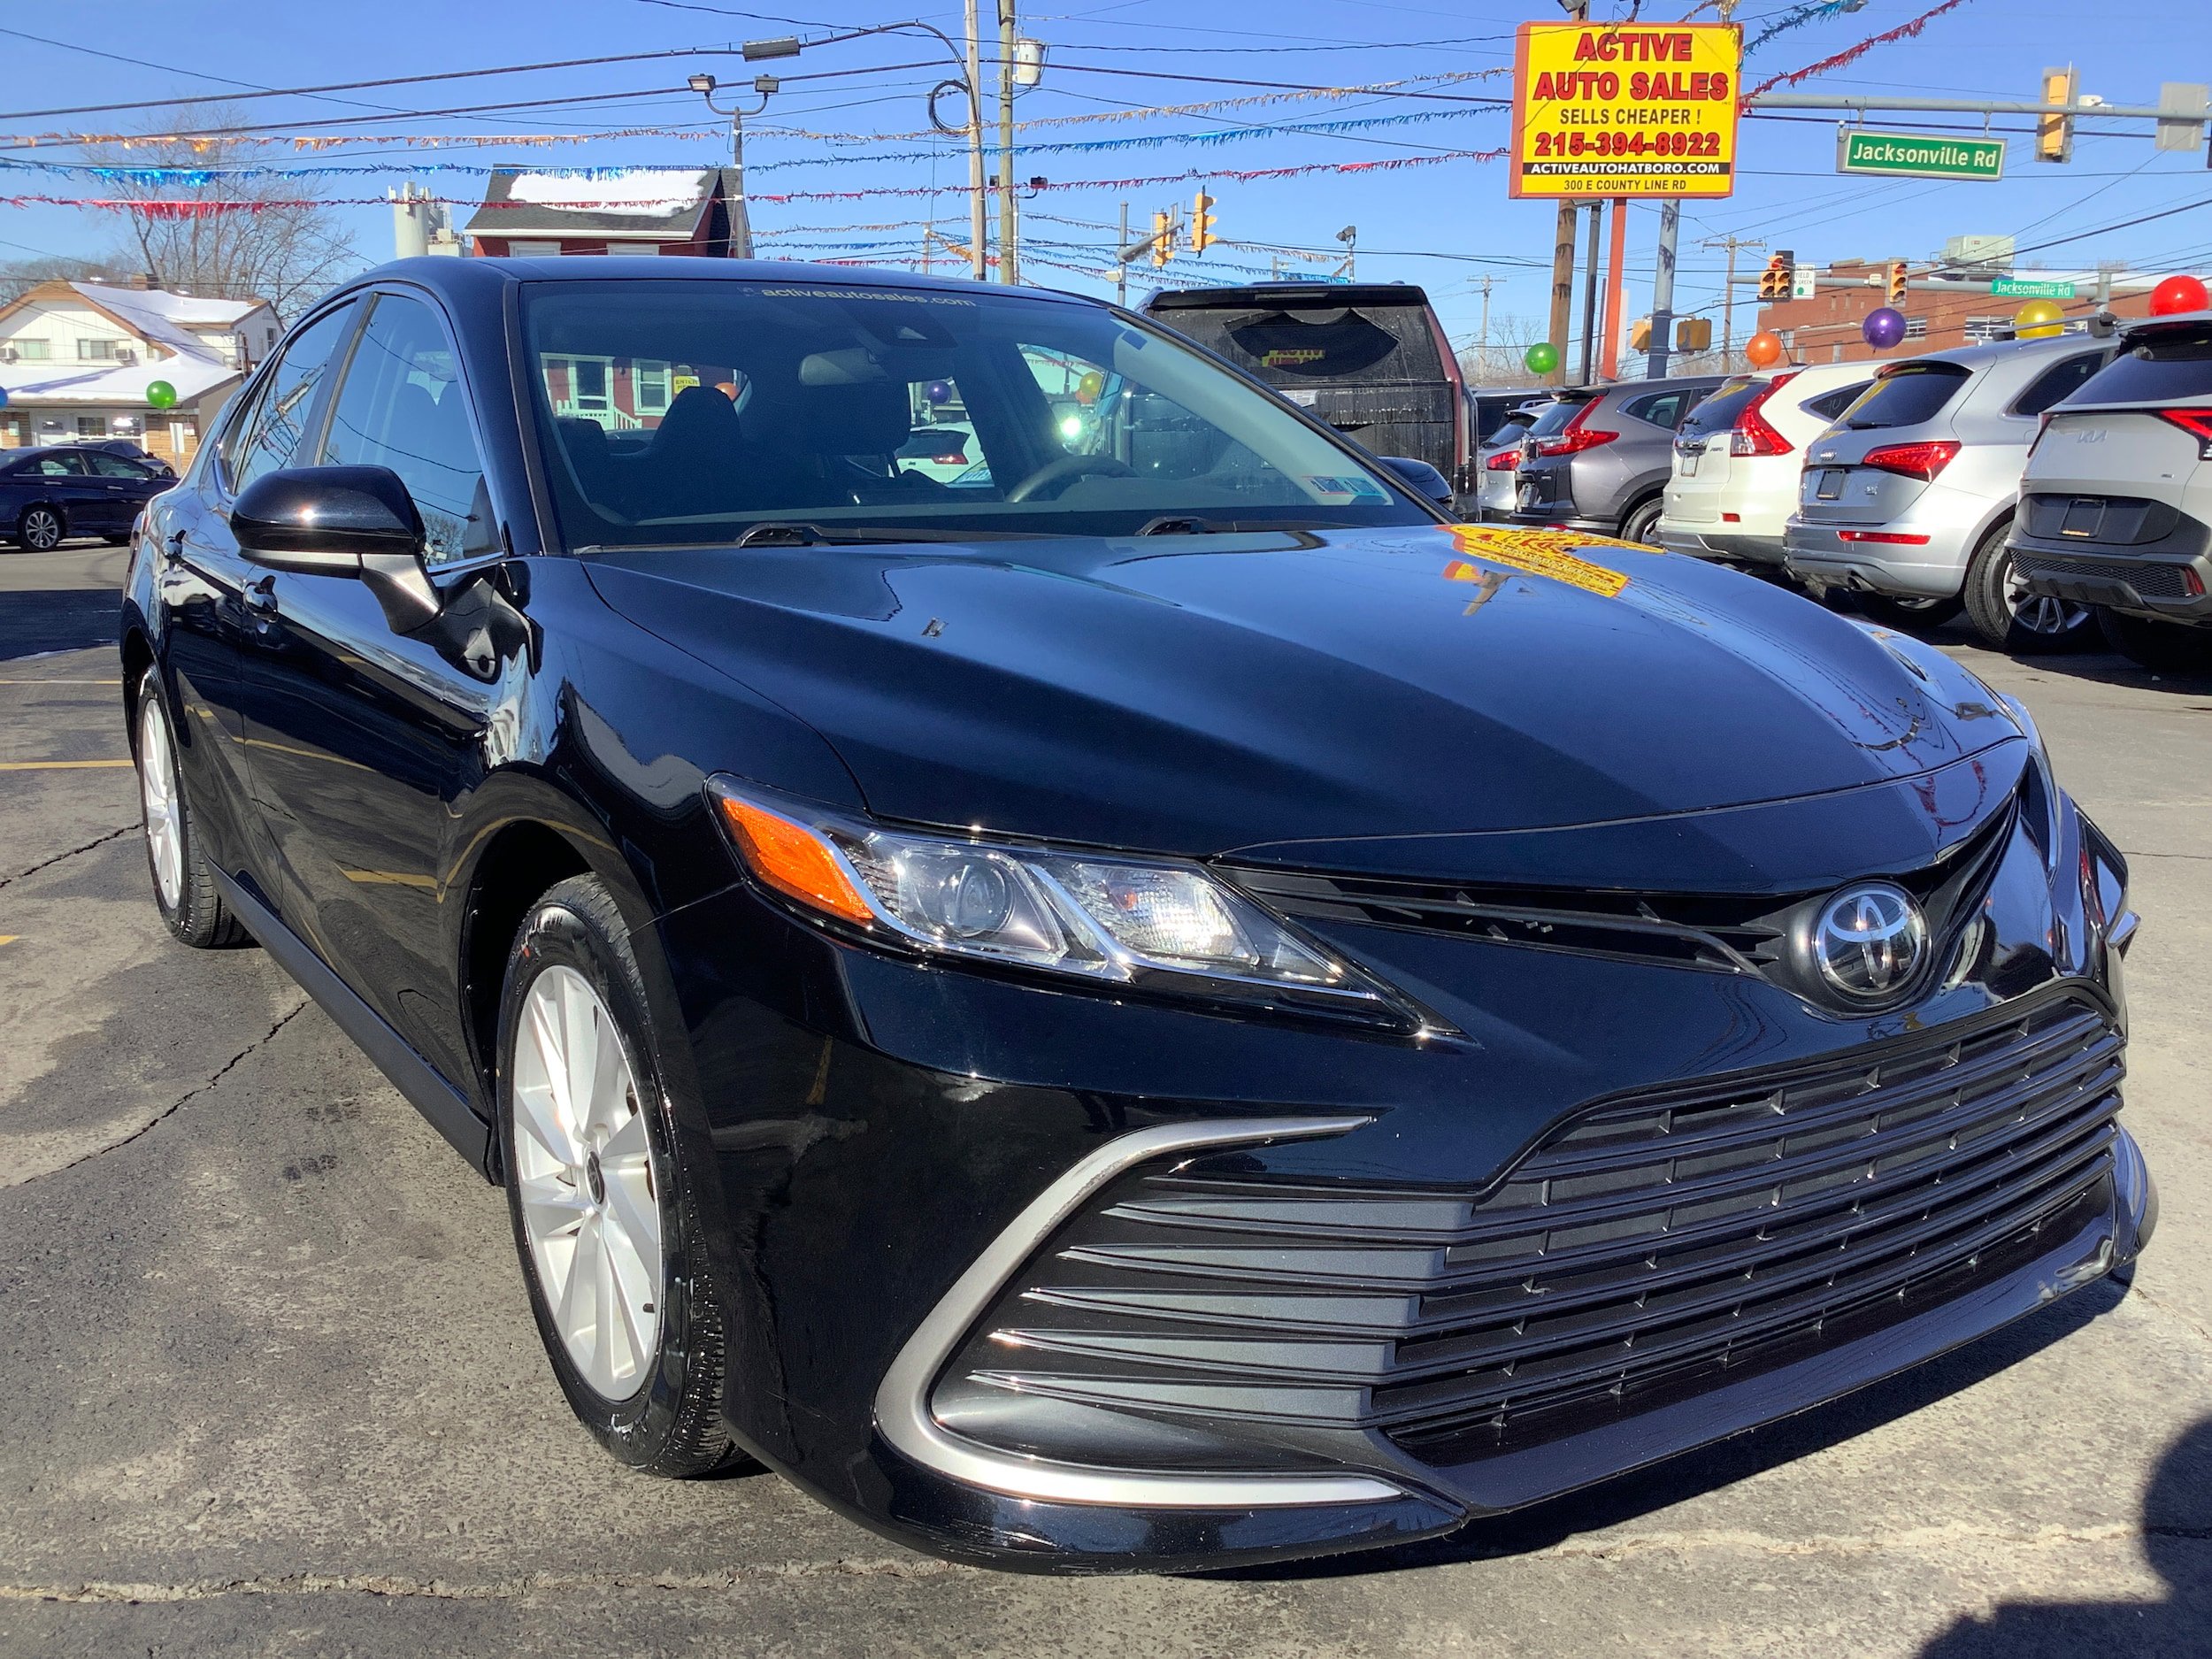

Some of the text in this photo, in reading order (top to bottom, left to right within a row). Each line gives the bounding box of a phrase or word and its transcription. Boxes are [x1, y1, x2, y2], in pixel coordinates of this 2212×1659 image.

[1573, 33, 1693, 61] ACTIVE
[1532, 72, 1728, 101] AUTO SALES
[1560, 109, 1609, 125] SELLS
[1616, 109, 1691, 125] CHEAPER
[1533, 132, 1720, 157] 215-394-8922
[1853, 142, 1997, 168] Jacksonville Rd
[1531, 163, 1720, 174] ACTIVEAUTOHATBORO.COM
[1564, 180, 1686, 190] 300 E COUNTY LINE RD
[1995, 281, 2070, 296] Jacksonville Rd
